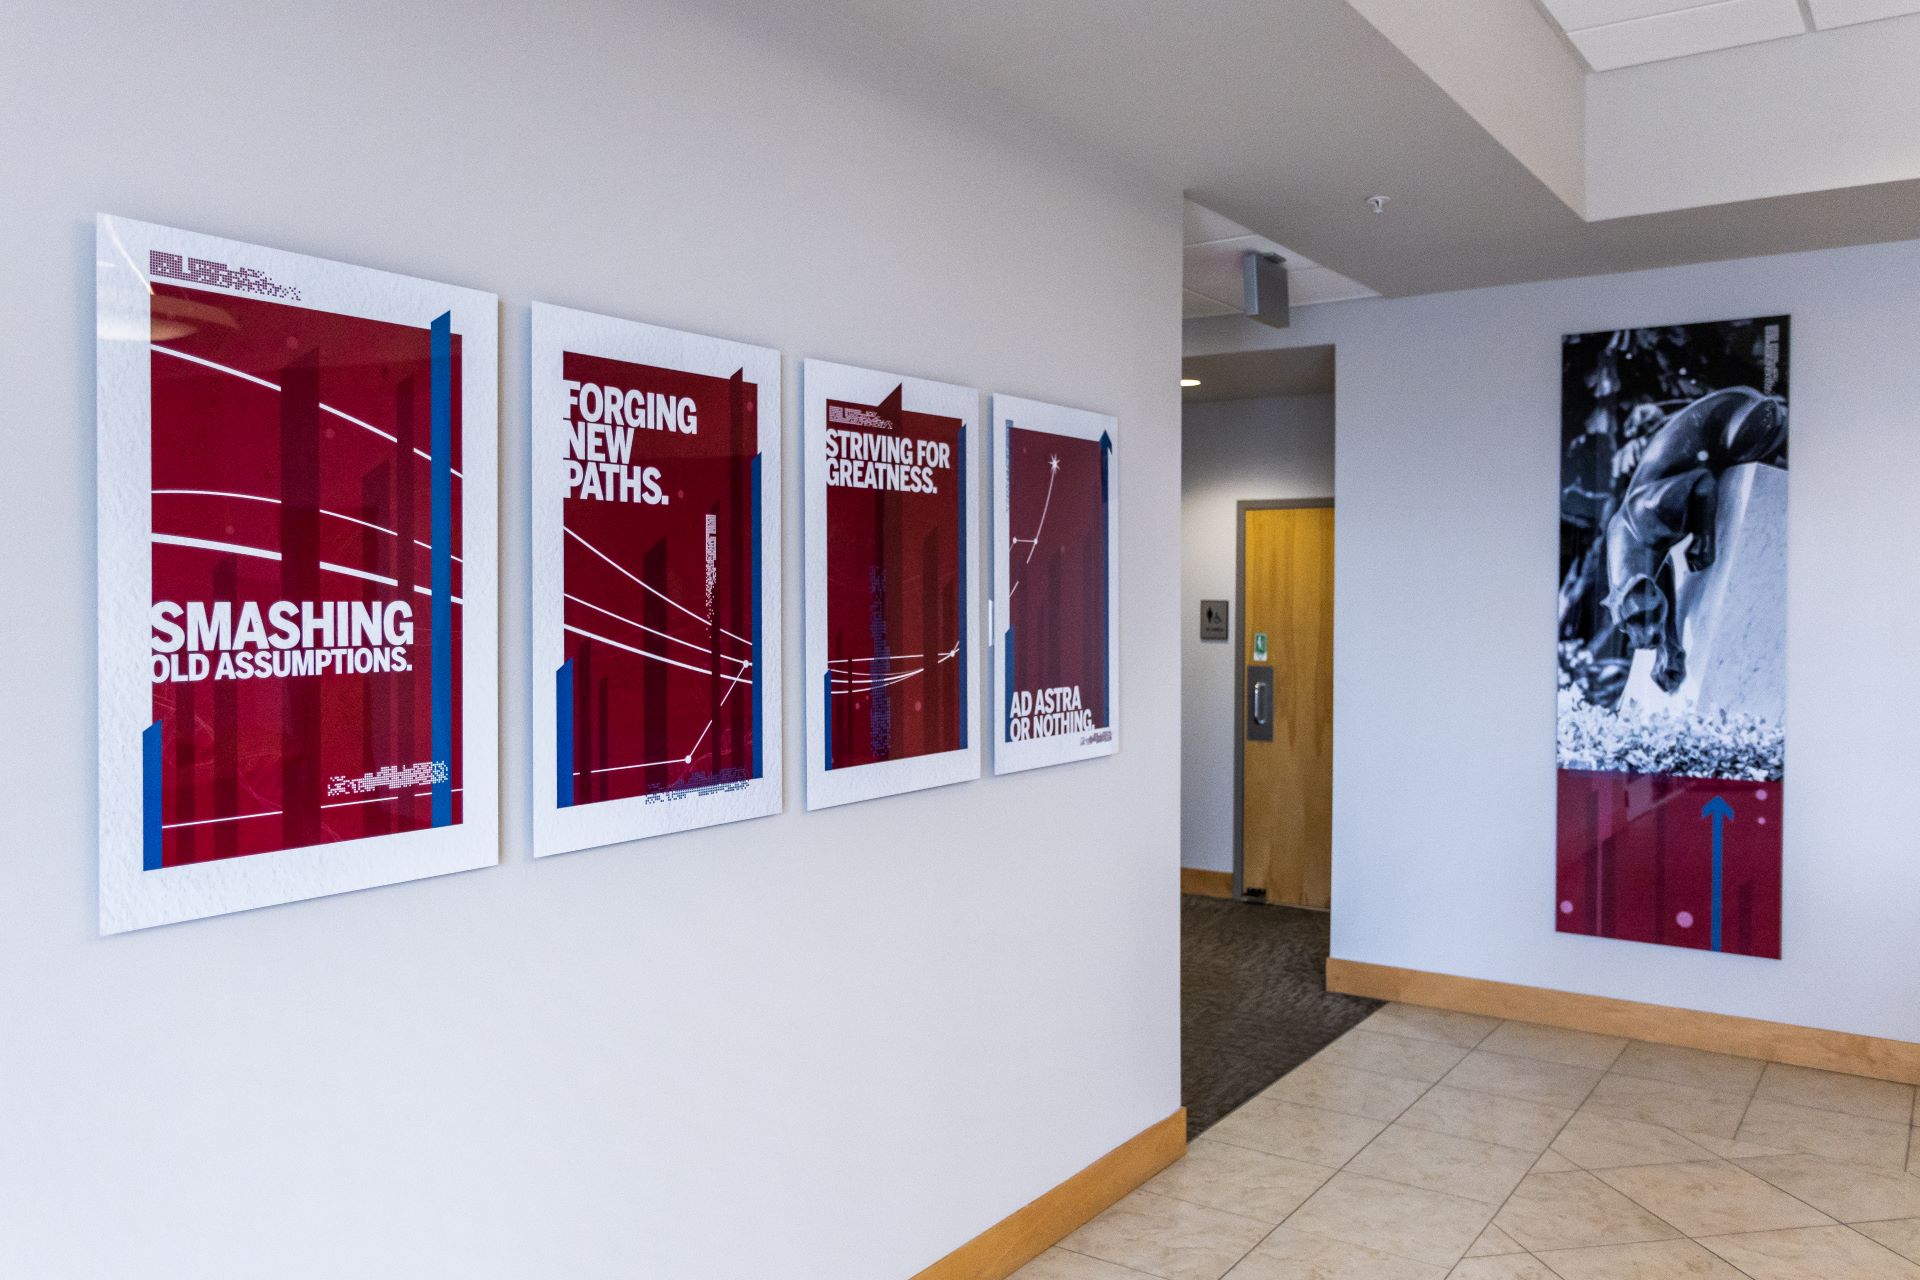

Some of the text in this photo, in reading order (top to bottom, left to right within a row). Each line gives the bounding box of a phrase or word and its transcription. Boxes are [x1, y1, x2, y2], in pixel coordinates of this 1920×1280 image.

[563, 380, 697, 435] FORGING
[563, 419, 635, 465] NEW
[826, 428, 950, 469] STRIVING FOR
[563, 460, 670, 506] PATHS.
[826, 457, 938, 494] GREATNESS.
[152, 600, 414, 653] SMASHING
[152, 647, 413, 683] OLD ASSUMPTIONS.
[1010, 685, 1082, 718] AD ASTRA
[1010, 708, 1096, 742] OR NOTHING.
